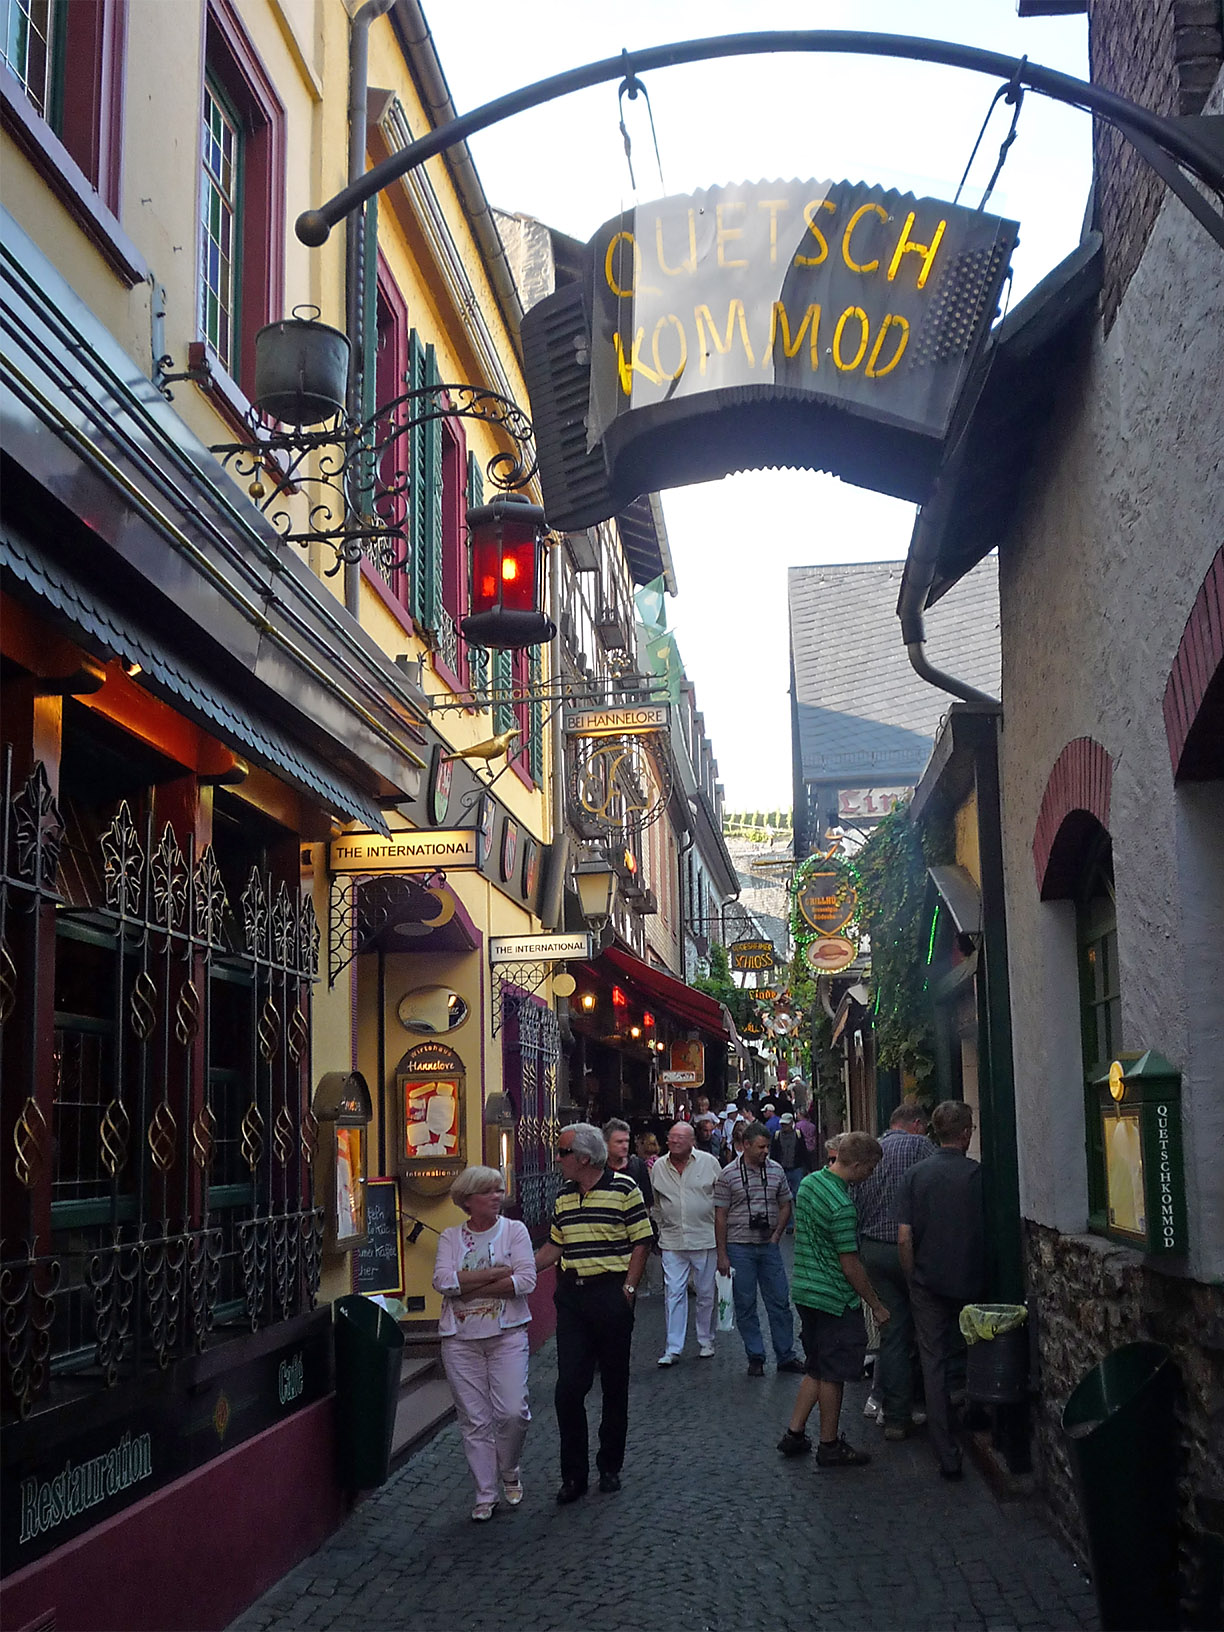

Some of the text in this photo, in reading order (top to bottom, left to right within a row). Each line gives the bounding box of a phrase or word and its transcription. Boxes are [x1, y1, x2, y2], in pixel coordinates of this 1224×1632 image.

[605, 199, 947, 298] QUETSCH
[613, 298, 910, 396] KOMMOD
[568, 710, 663, 729] BEI HANNELORE
[336, 842, 474, 859] THE INTERNATIONAL
[495, 940, 586, 954] THE INTERNATIONAL
[735, 952, 774, 968] SCHLOSS
[407, 1060, 455, 1072] Hannelore
[1157, 1105, 1175, 1248] QUETSCHKOMMOD
[278, 1350, 304, 1405] Café
[19, 1430, 153, 1545] Restauration
